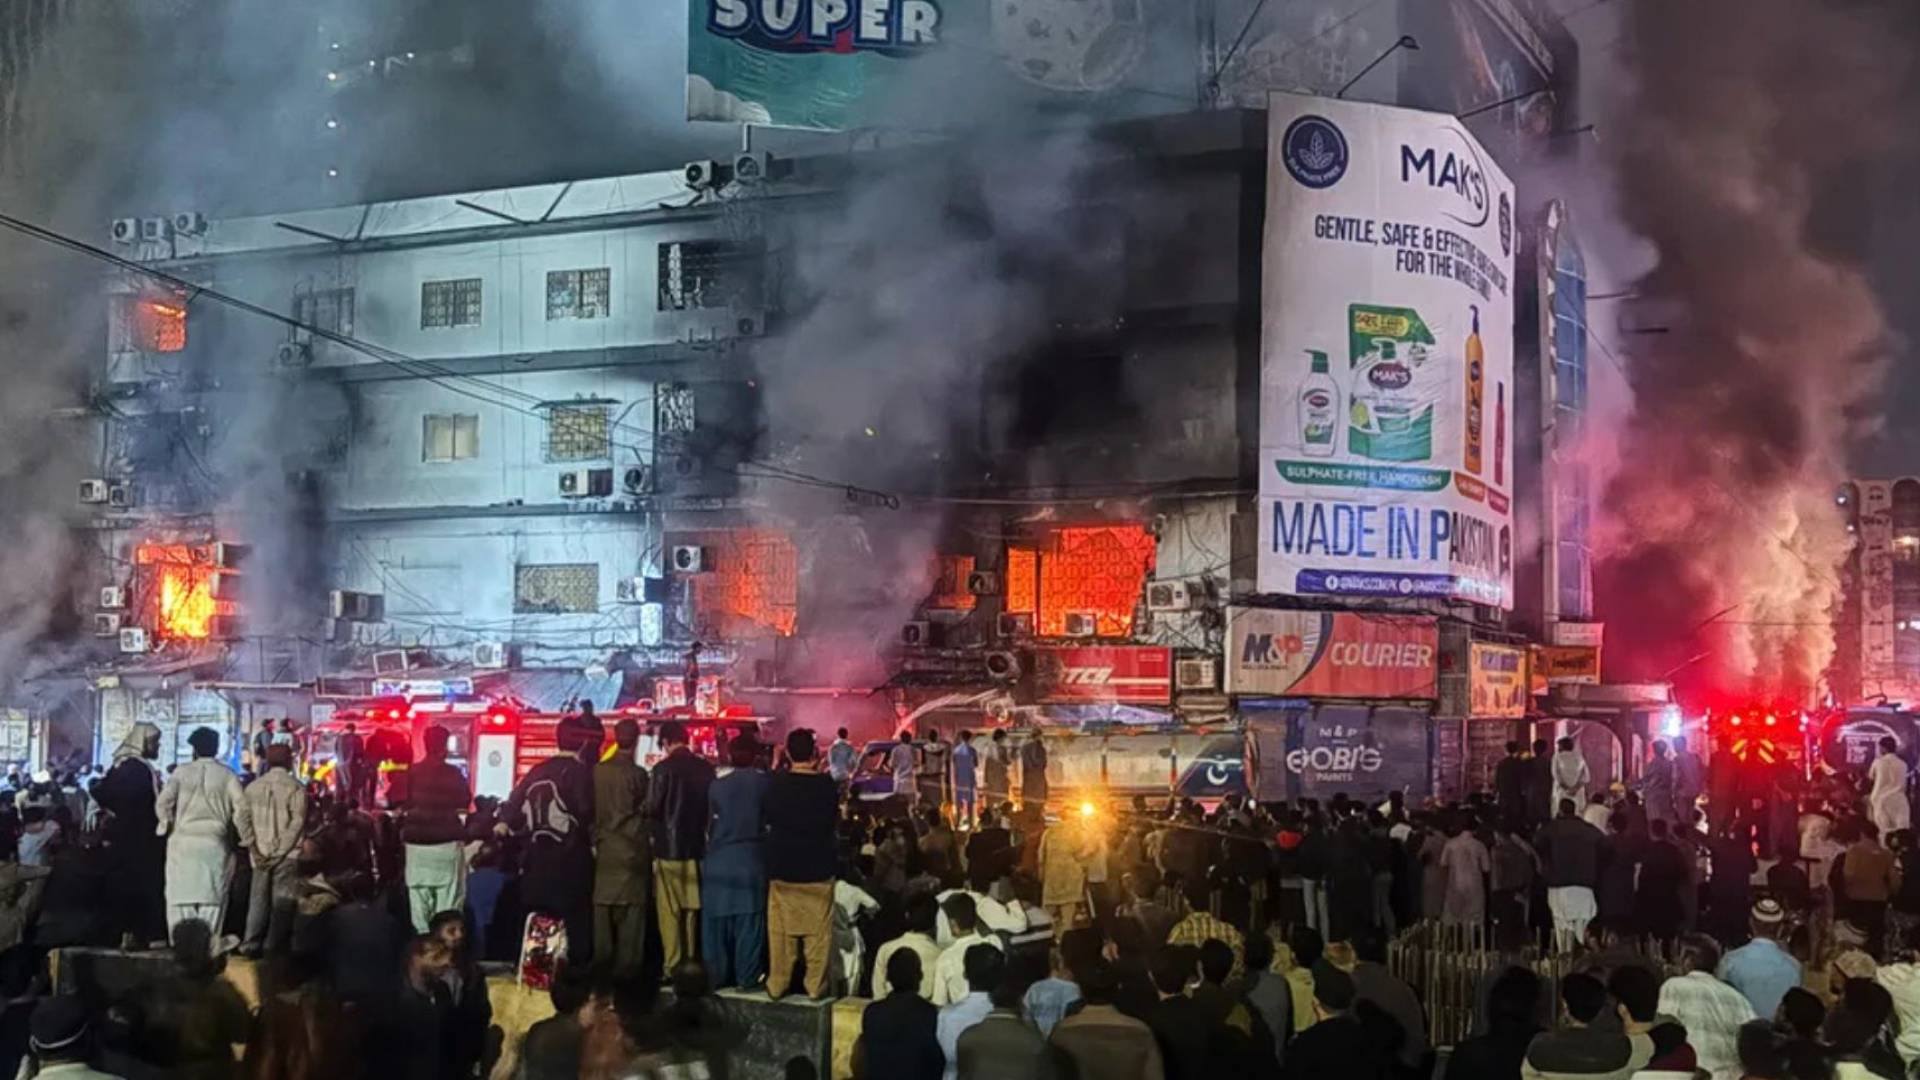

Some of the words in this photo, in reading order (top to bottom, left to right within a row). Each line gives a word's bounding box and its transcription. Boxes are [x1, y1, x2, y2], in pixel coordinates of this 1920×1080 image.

[714, 0, 937, 43] SUPER
[1314, 214, 1379, 246] GENTLE,
[1382, 222, 1420, 249] SAFE
[1423, 228, 1434, 250] &
[1396, 249, 1426, 274] FOR
[1428, 252, 1454, 279] THE
[1286, 465, 1378, 484] SULPHATE-FREE
[1272, 500, 1377, 558] MADE
[1387, 506, 1420, 560] IN
[1242, 633, 1303, 664] M&P
[1329, 640, 1432, 669] COURIER
